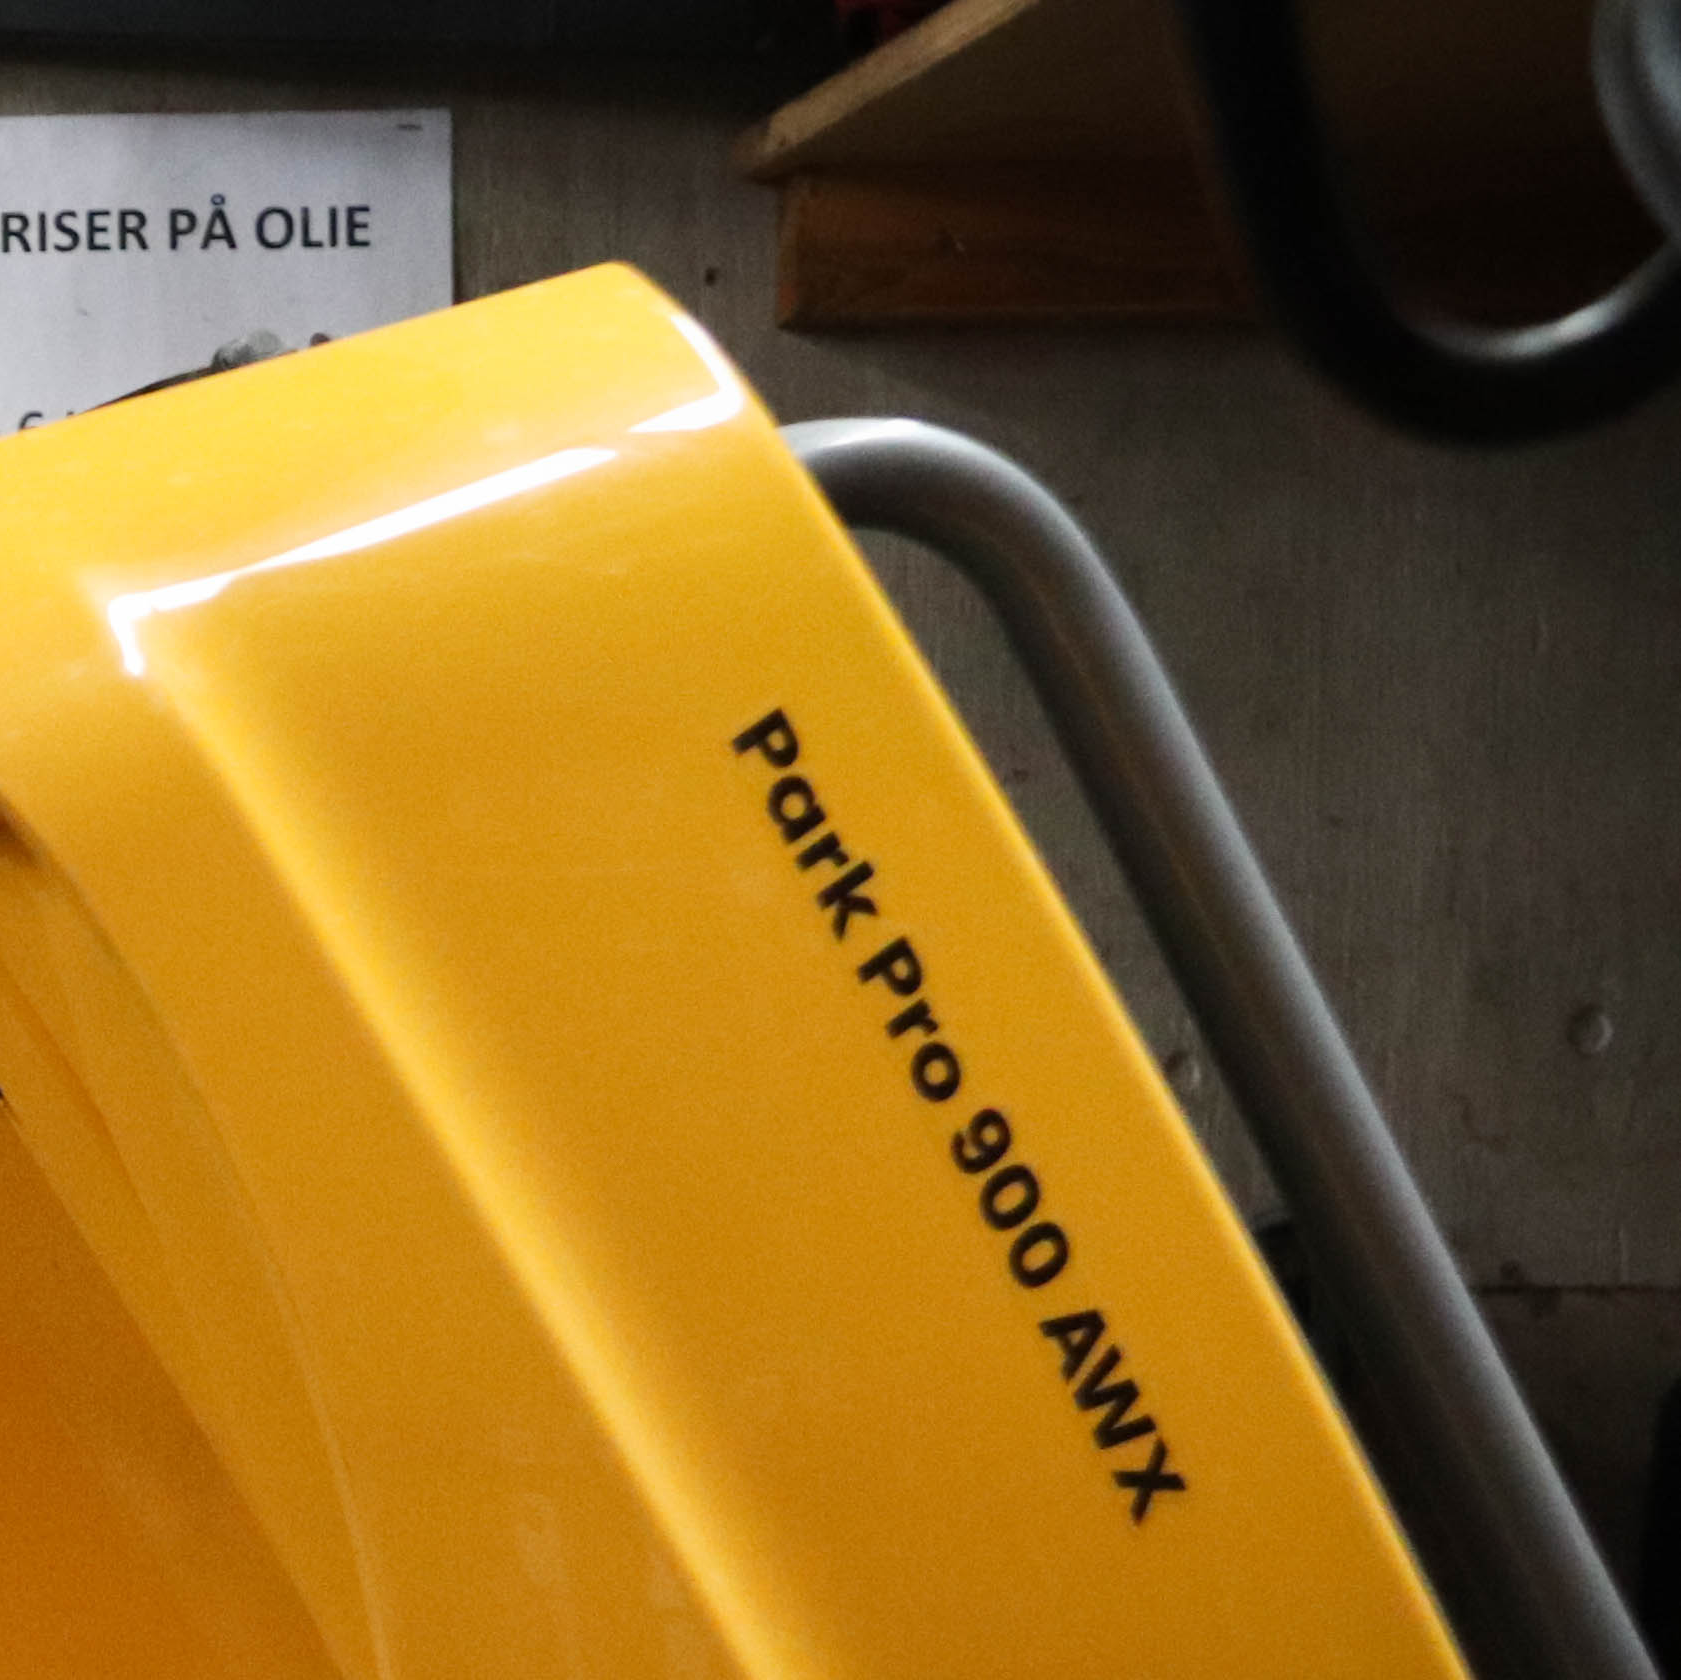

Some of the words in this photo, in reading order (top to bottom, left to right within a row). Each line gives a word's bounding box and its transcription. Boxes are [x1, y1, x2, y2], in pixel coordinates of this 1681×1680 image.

[168, 193, 239, 252] PÅ
[254, 204, 372, 251] OLIE
[732, 709, 878, 941] Park
[857, 936, 962, 1103] Pro
[951, 1108, 1071, 1289] 900
[1038, 1309, 1189, 1527] AWX
